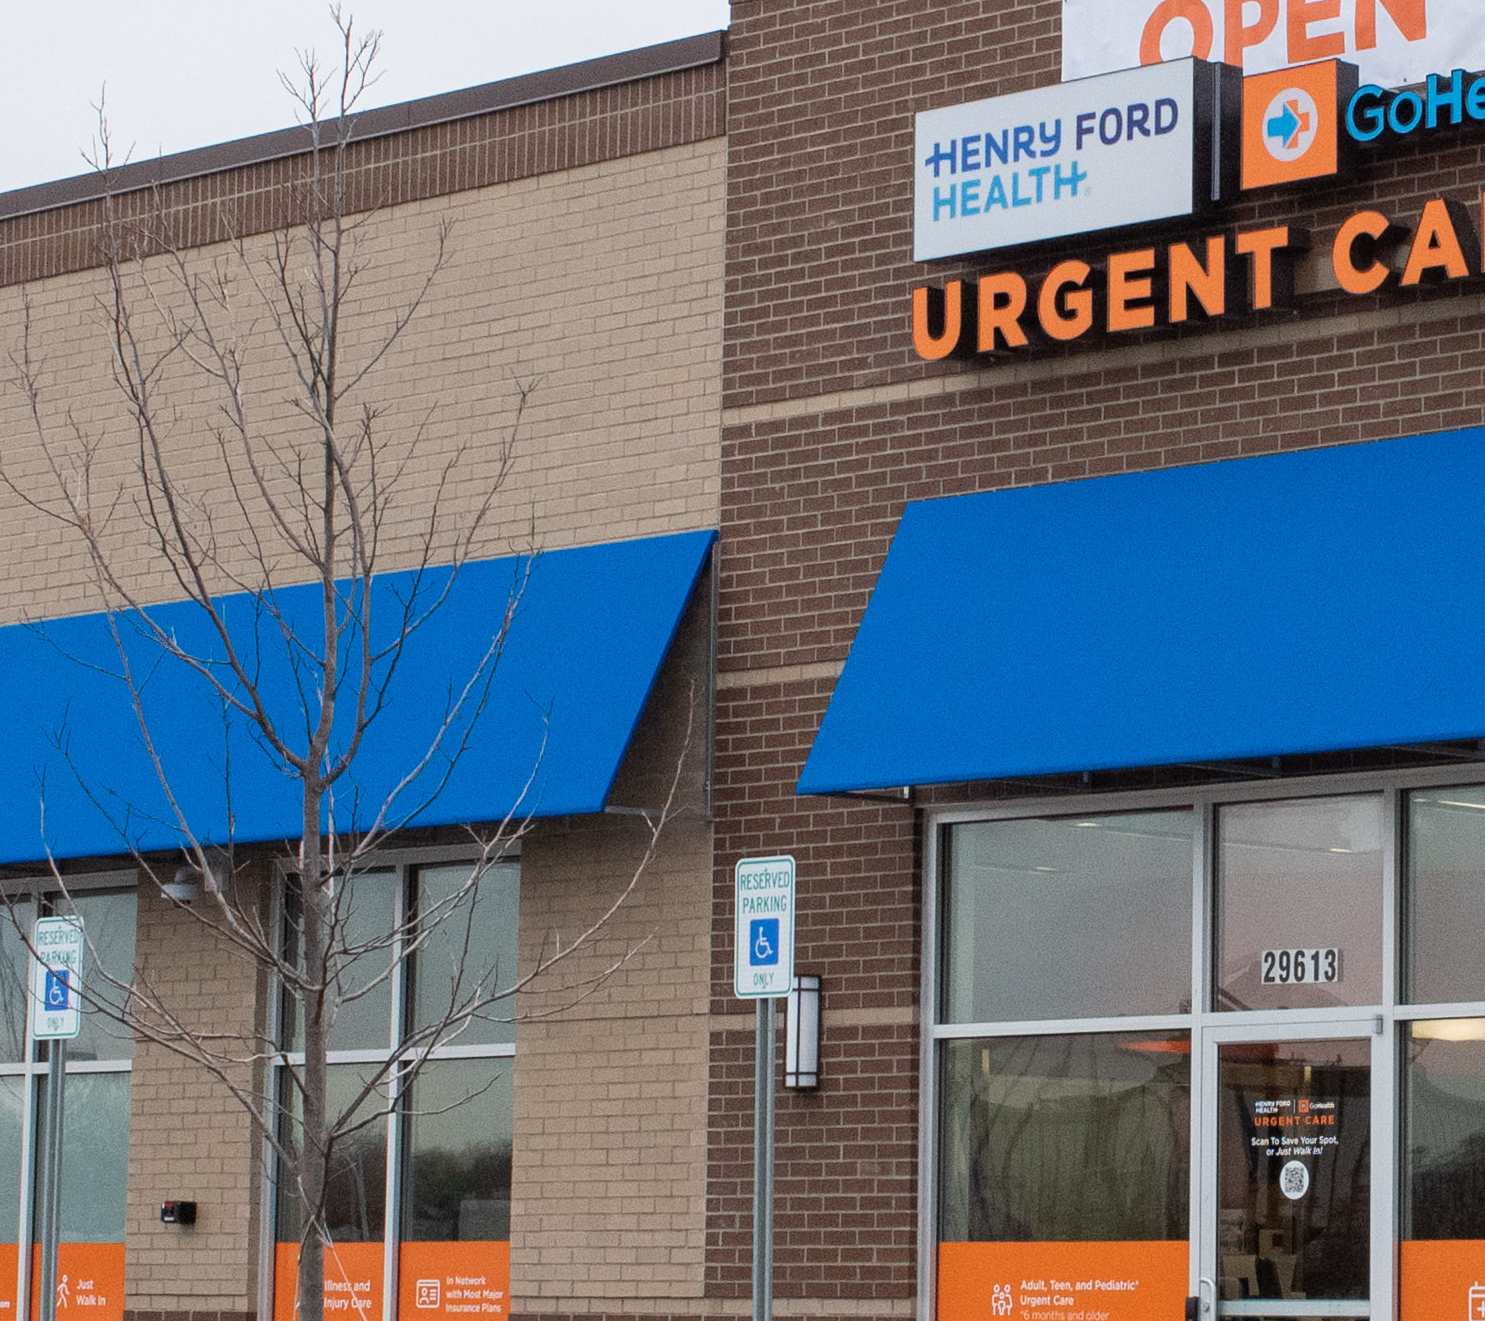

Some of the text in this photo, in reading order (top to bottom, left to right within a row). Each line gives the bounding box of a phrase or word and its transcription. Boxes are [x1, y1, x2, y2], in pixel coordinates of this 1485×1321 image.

[925, 97, 1179, 177] HENRY FORD
[932, 161, 1087, 222] HEALTH
[913, 226, 1289, 360] URGENT
[740, 871, 790, 890] RESERVED
[742, 895, 787, 913] PARKING
[38, 930, 80, 945] RESERVED
[40, 951, 77, 965] PARKING
[1264, 949, 1336, 983] 29613
[753, 972, 774, 986] ONLY
[1254, 1115, 1335, 1126] URGENT CARE
[1251, 1137, 1269, 1146] Scan
[1271, 1137, 1280, 1145] To
[1281, 1137, 1299, 1145] Save
[1301, 1136, 1317, 1145] Your
[1275, 1148, 1291, 1156] Just
[1293, 1147, 1312, 1155] Walk
[76, 1279, 93, 1290] Just
[324, 1280, 371, 1291] Illness and
[446, 1276, 486, 1286] In Network
[1020, 1280, 1047, 1292] Adult,
[1050, 1280, 1073, 1292] Teen,
[1075, 1280, 1092, 1291] and
[76, 1294, 107, 1306] Walk In
[446, 1289, 504, 1300] with Most Major
[323, 1297, 372, 1310] Injury Care
[1020, 1295, 1074, 1307] Urgent Care
[445, 1303, 502, 1313] Insurance Plans
[1031, 1310, 1065, 1321] months
[1067, 1310, 1084, 1321] and
[1086, 1310, 1109, 1321] older
